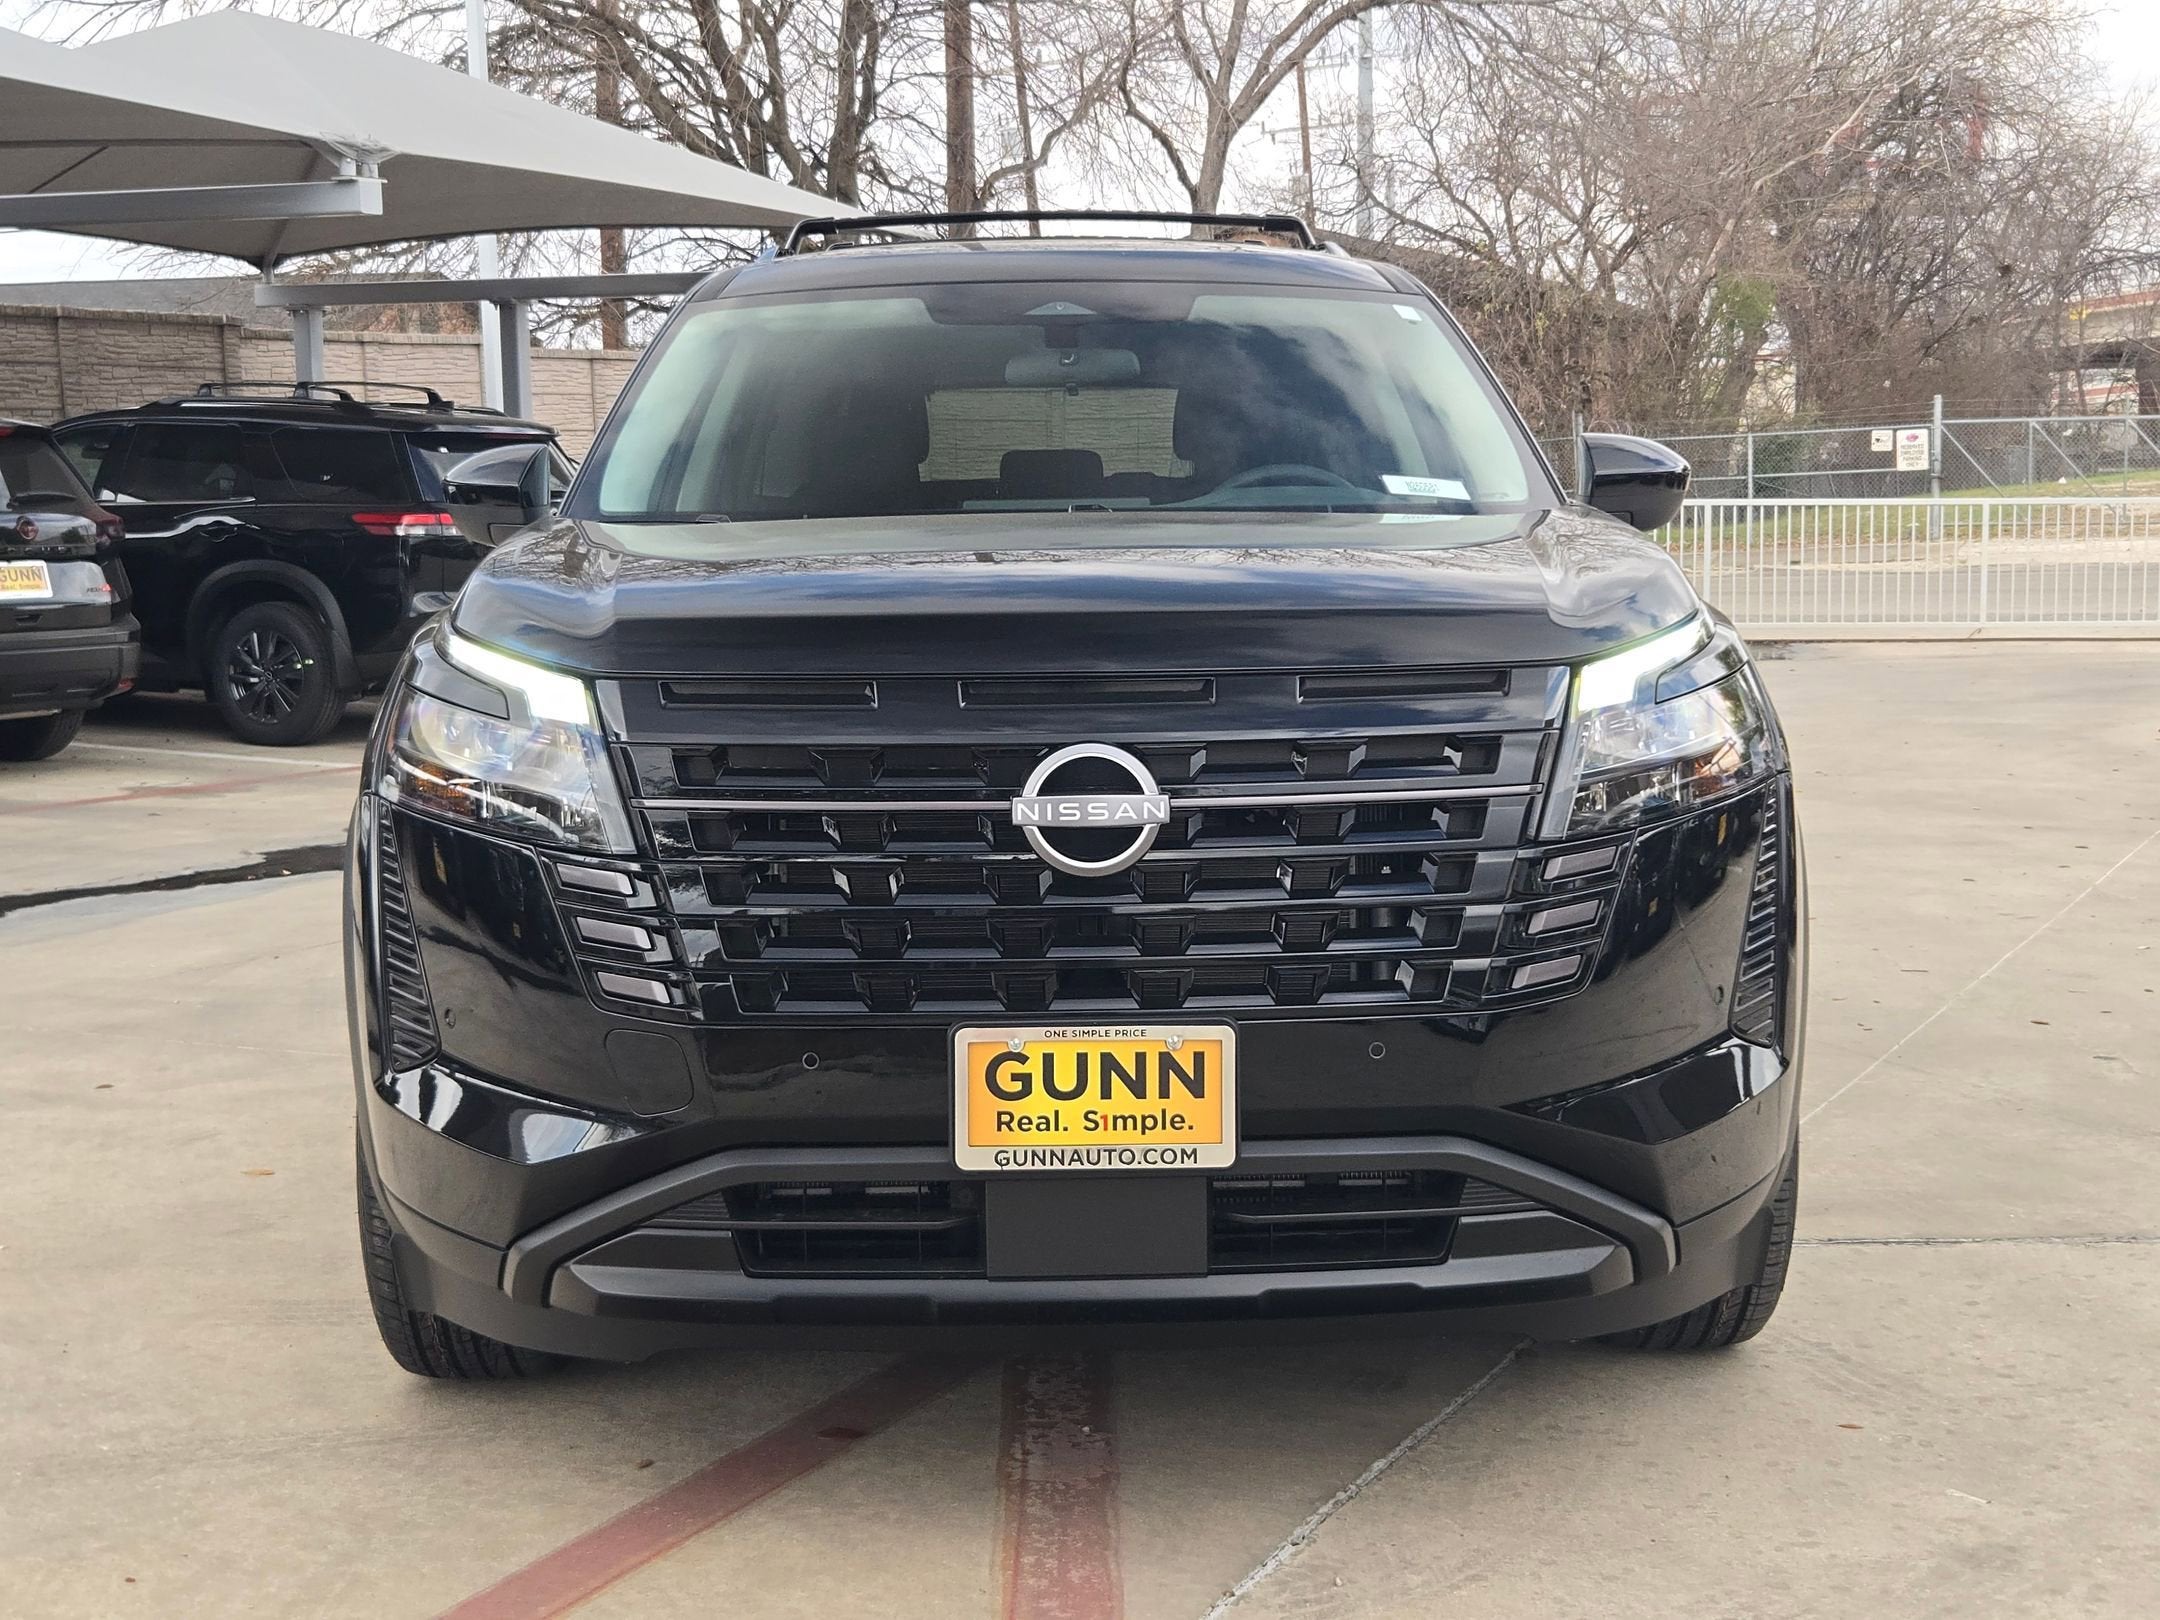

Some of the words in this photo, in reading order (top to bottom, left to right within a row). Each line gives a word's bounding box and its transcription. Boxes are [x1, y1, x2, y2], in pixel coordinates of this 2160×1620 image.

[1017, 801, 1165, 821] NISSAN
[1044, 1029, 1068, 1038] ONE
[1071, 1029, 1111, 1038] SIMPLE
[1114, 1028, 1147, 1037] PRICE
[984, 1050, 1205, 1101] GUNN
[996, 1109, 1069, 1132] Real.
[994, 1147, 1198, 1167] GUNNAUTO.COM
